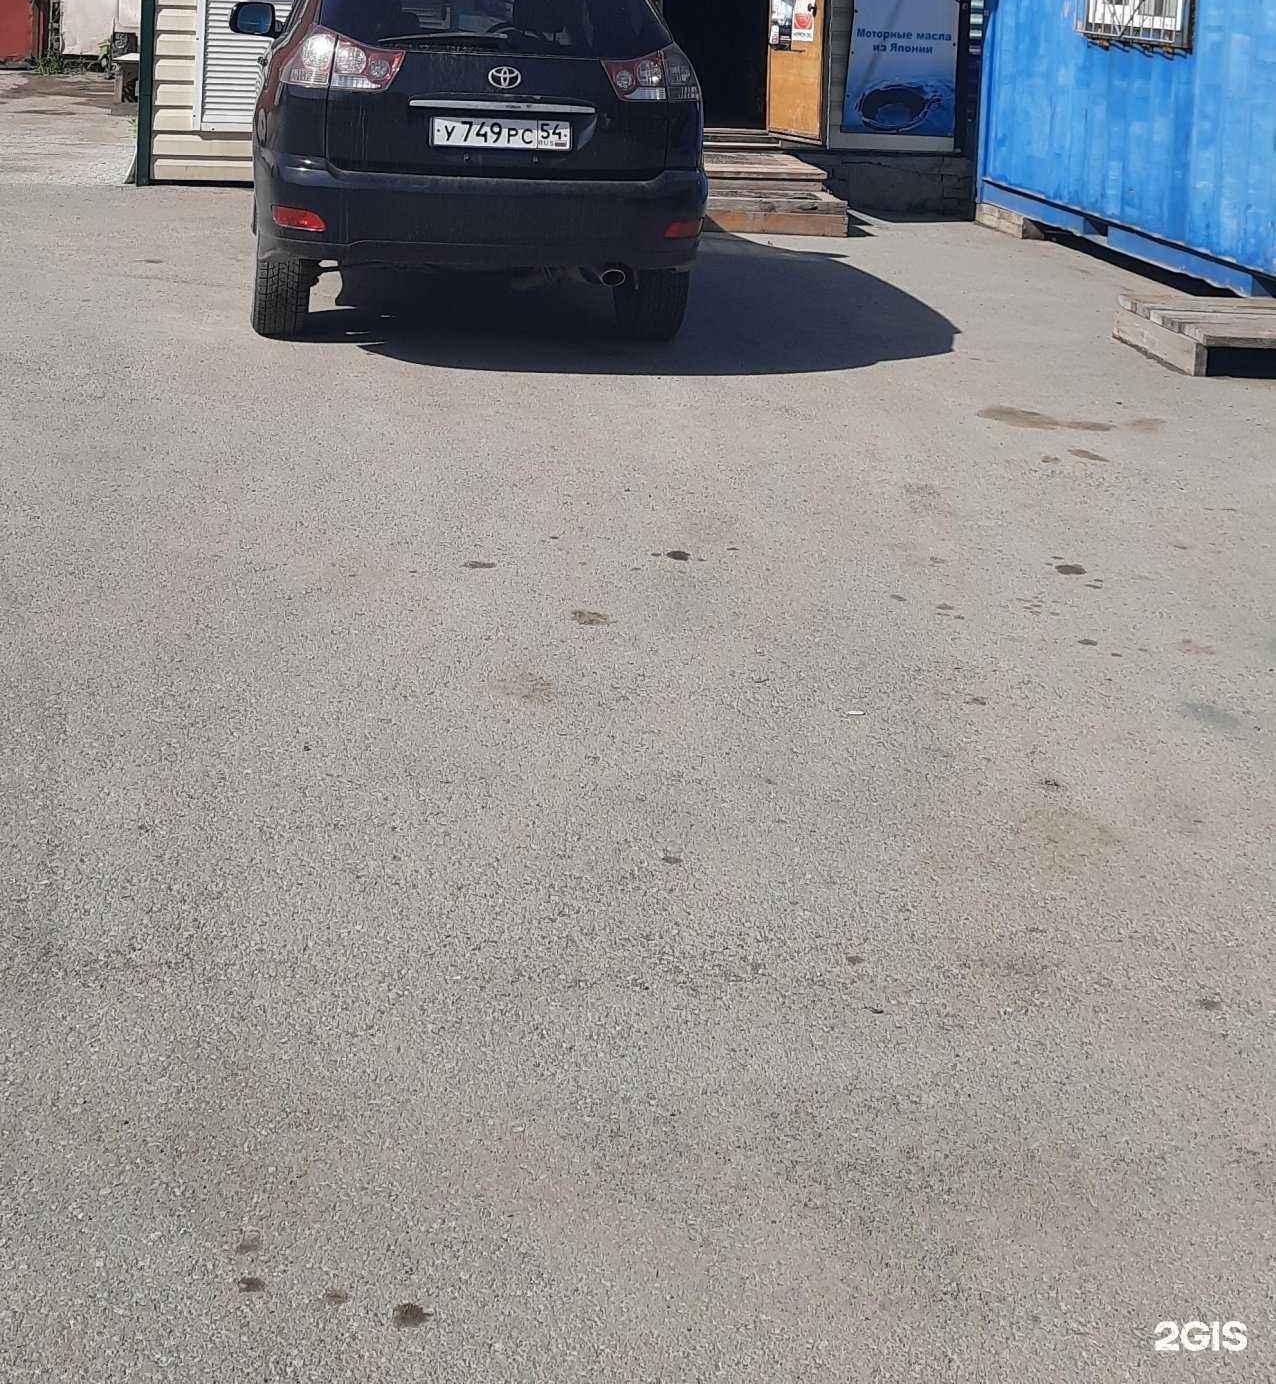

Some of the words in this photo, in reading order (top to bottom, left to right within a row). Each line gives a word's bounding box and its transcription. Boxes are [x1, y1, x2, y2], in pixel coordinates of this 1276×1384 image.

[857, 28, 912, 41] Моторные
[917, 31, 953, 41] масла
[873, 44, 887, 52] из
[889, 43, 934, 54] Японии
[540, 124, 562, 140] 54
